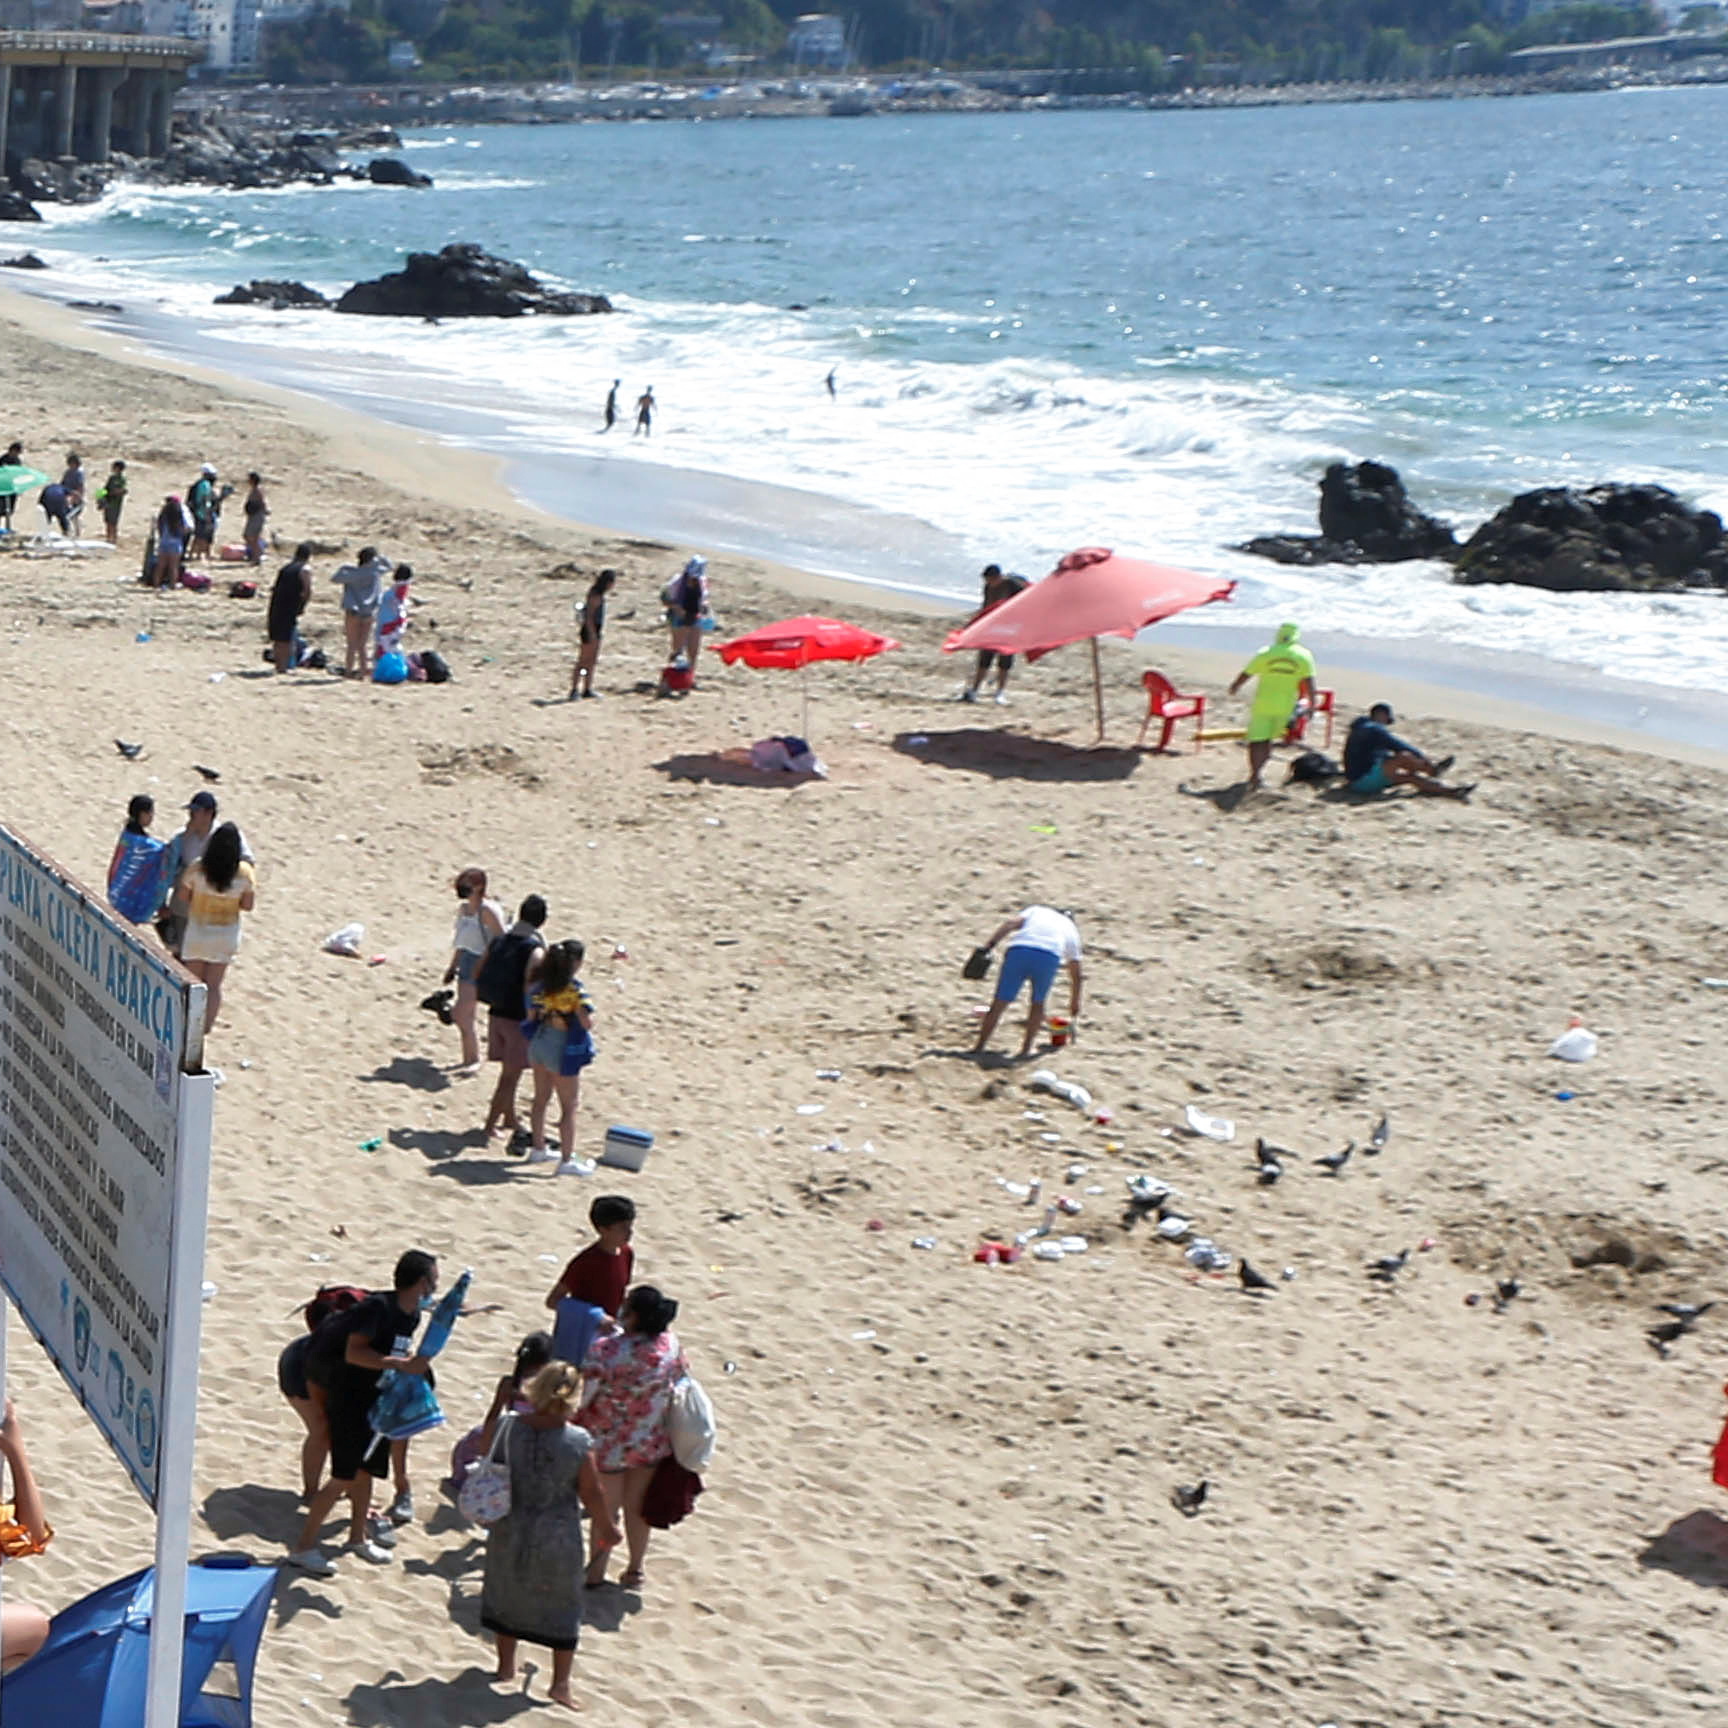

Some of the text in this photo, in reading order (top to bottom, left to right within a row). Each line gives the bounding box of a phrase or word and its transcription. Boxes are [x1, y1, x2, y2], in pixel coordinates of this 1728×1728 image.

[0, 847, 175, 1052] PLAYA CALETA ABARCA
